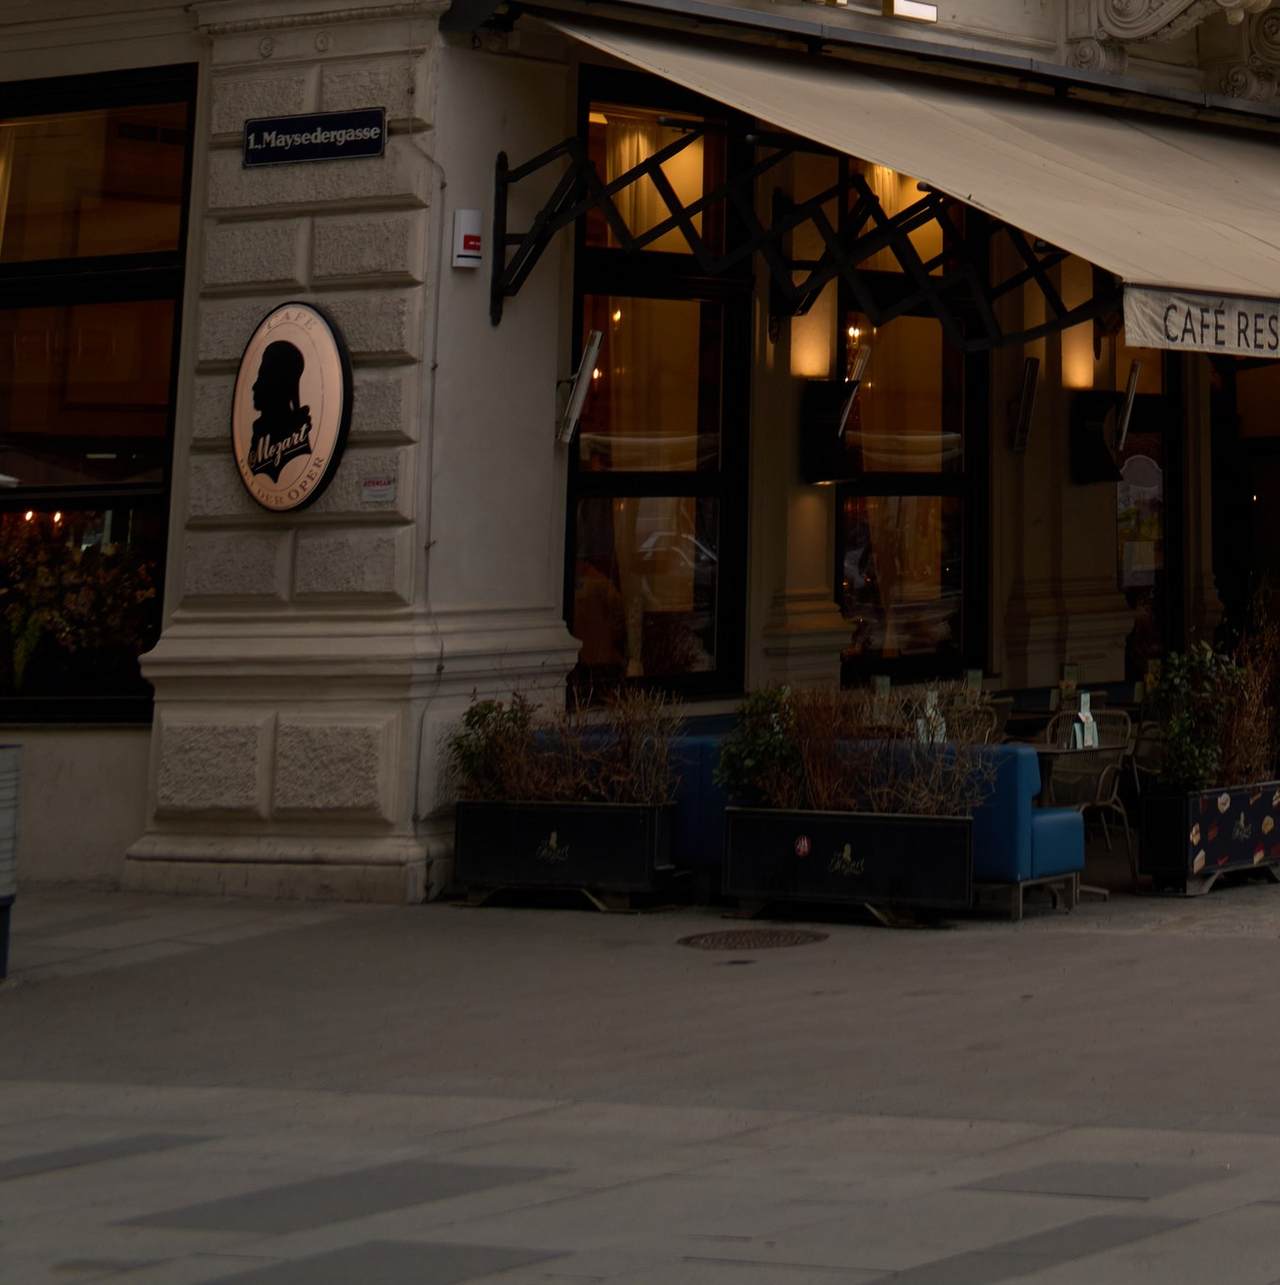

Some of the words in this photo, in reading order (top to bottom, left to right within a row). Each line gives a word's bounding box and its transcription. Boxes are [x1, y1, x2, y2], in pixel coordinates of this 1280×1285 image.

[263, 126, 381, 149] Maysedergasse
[1162, 300, 1226, 347] CAFÉ
[250, 422, 309, 469] Mozart
[287, 457, 325, 501] OPER
